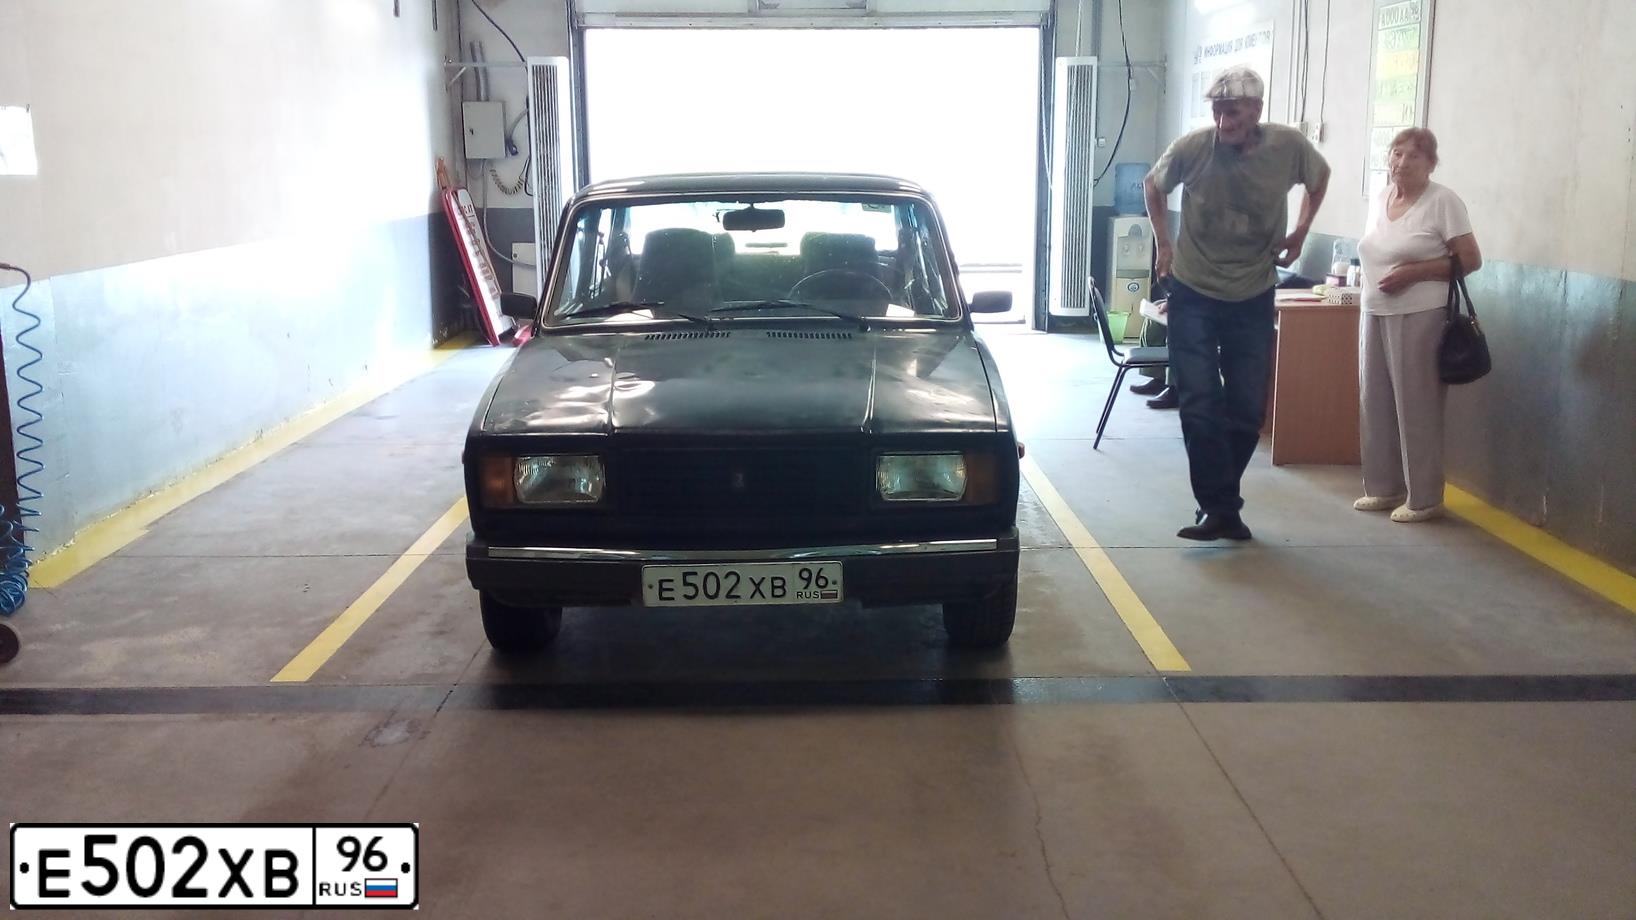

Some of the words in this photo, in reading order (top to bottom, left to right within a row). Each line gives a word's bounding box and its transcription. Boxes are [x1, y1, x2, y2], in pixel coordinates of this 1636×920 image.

[658, 571, 787, 601] Е502ХВ
[798, 567, 829, 590] 96
[796, 591, 820, 600] RUS
